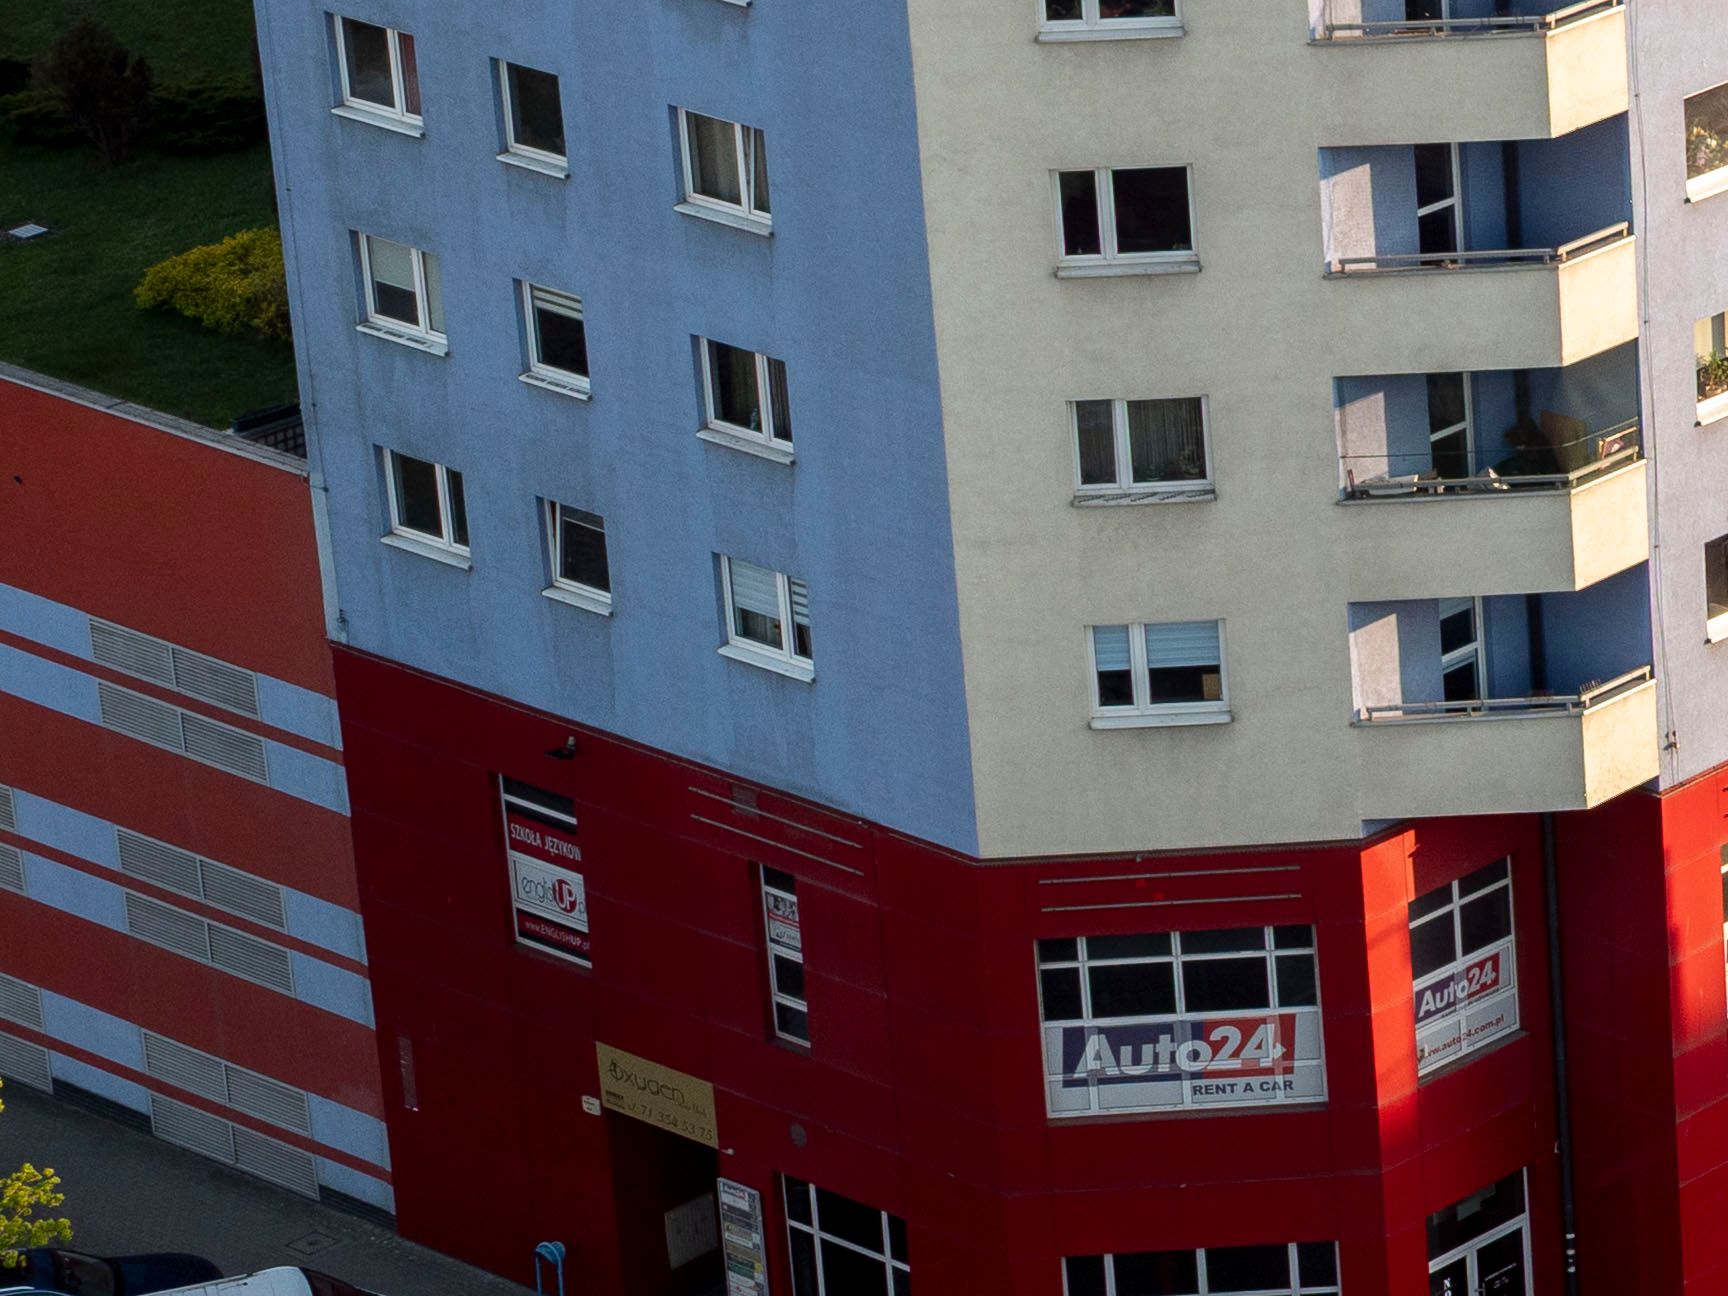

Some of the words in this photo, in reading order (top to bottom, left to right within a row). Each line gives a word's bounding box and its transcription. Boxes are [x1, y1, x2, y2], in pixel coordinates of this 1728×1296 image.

[510, 823, 543, 848] SZKOŁA
[1418, 960, 1497, 1018] Auto24
[1074, 1023, 1288, 1079] Auto24
[1419, 1016, 1505, 1060] ww.auto24.com.pl
[1192, 1083, 1237, 1098] RENT
[1242, 1082, 1256, 1095] A
[1259, 1079, 1295, 1094] CAR
